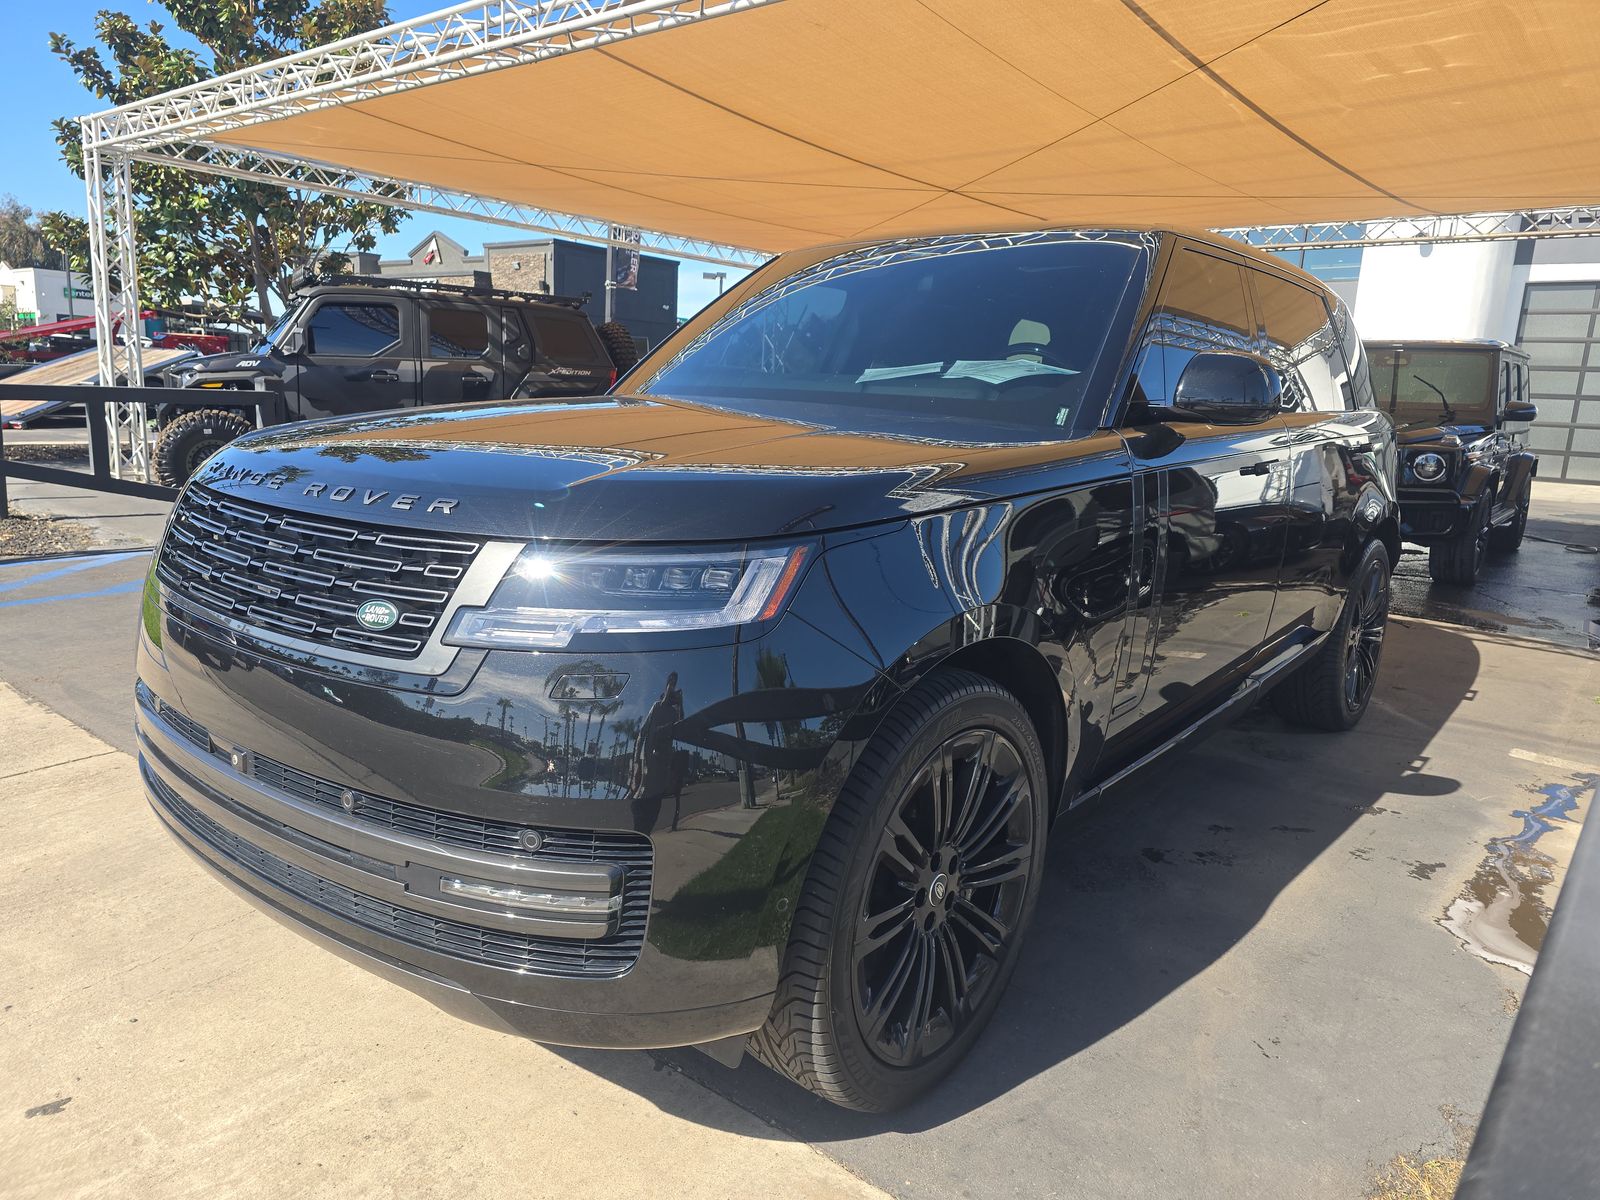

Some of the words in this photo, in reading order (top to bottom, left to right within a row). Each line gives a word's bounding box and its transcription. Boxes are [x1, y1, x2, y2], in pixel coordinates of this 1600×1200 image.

[235, 360, 261, 368] ADV
[208, 461, 288, 490] RANGE
[302, 481, 460, 515] ROVER
[365, 605, 386, 615] LAND
[364, 613, 390, 624] ROVER
